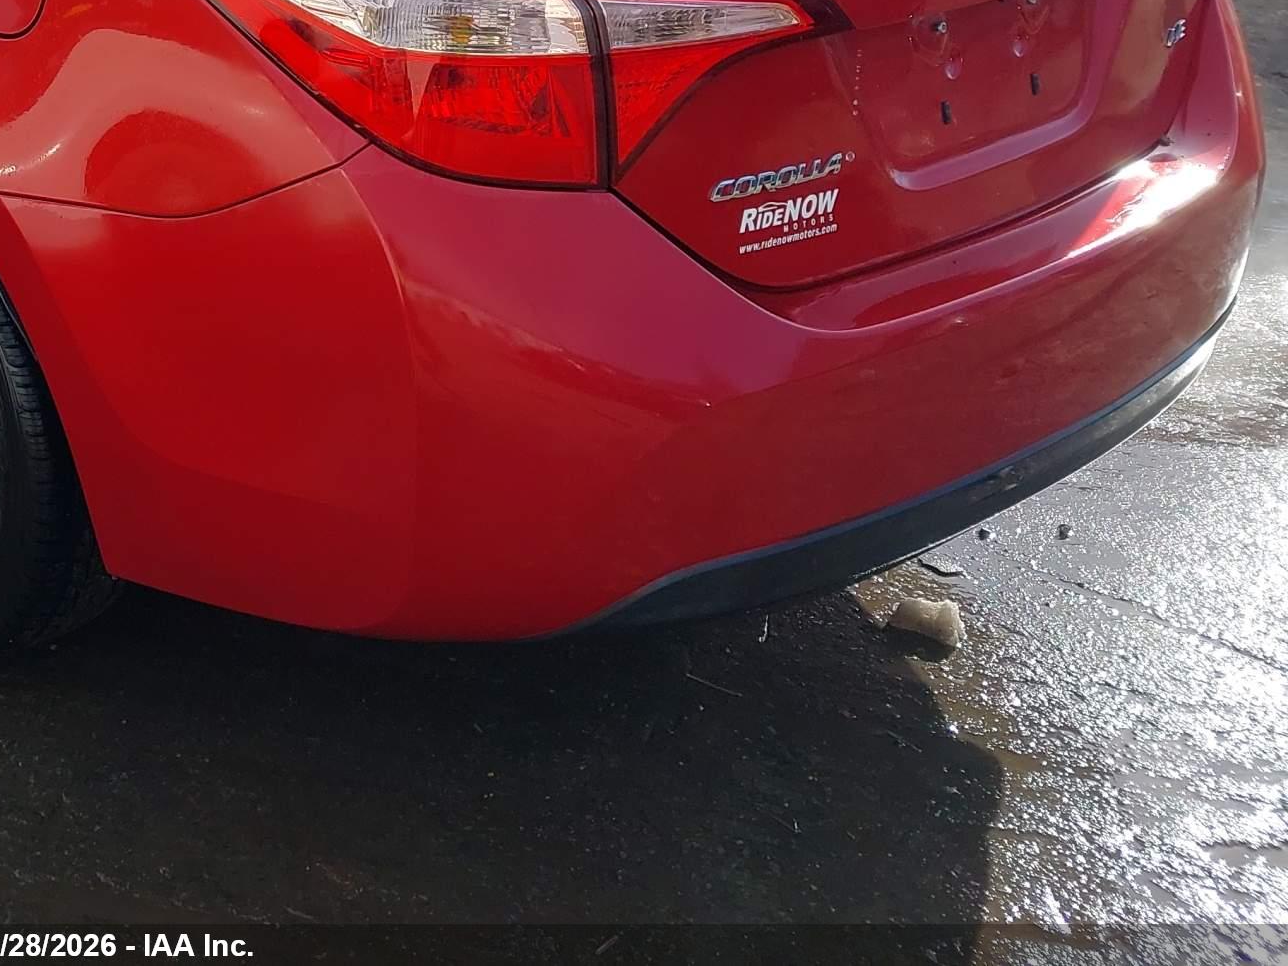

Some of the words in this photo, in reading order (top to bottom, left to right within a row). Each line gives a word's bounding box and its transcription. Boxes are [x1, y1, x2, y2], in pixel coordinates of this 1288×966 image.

[710, 152, 843, 202] COROLLA
[738, 223, 838, 254] www.ridenowmotors.com
[782, 215, 834, 233] MOTORS
